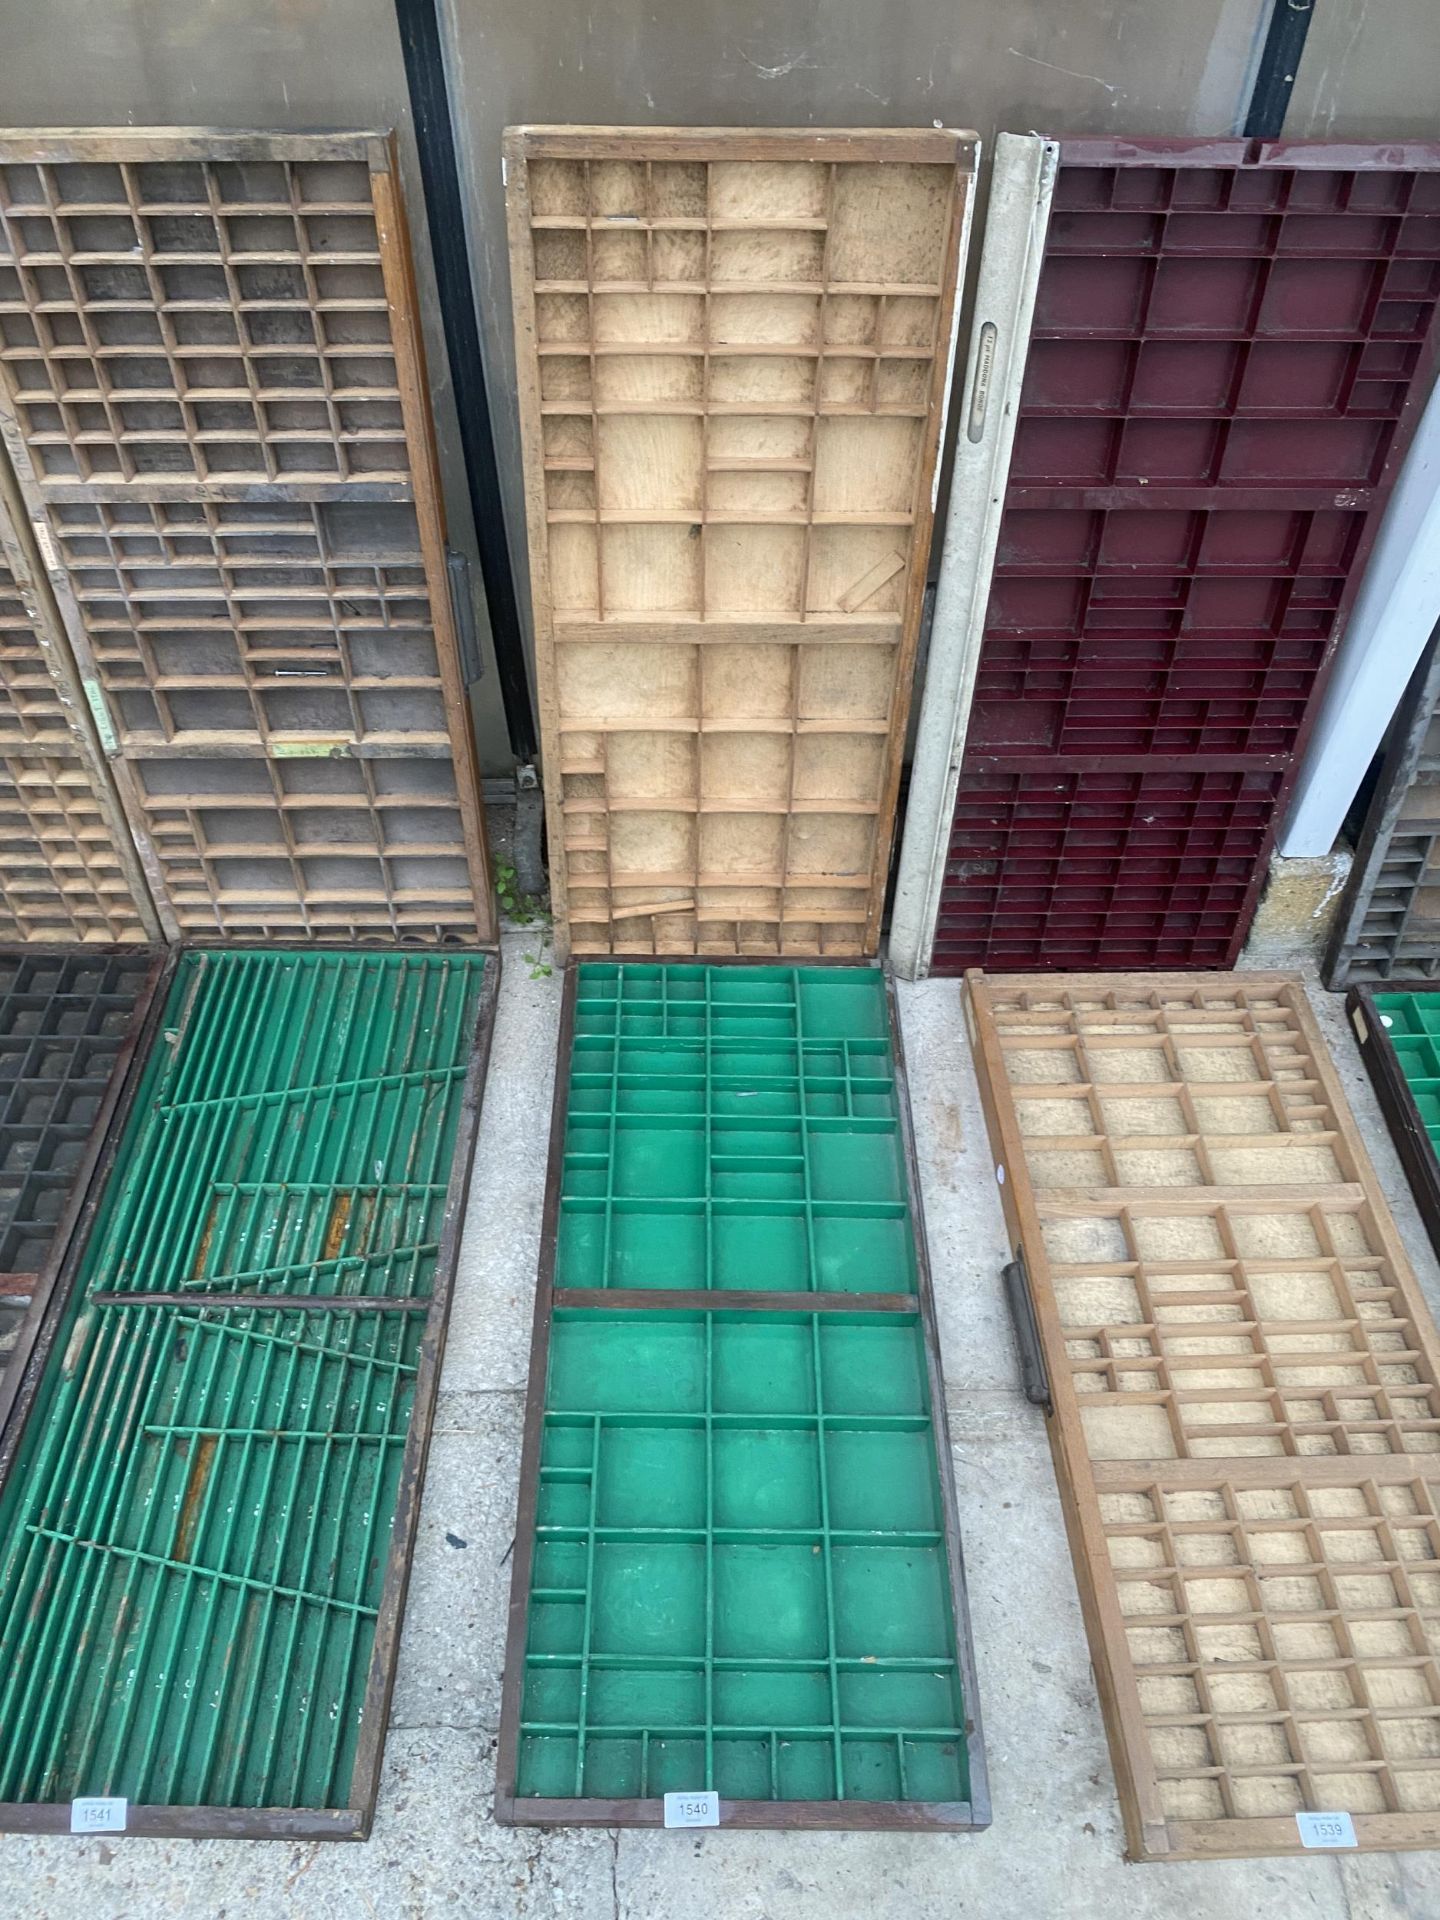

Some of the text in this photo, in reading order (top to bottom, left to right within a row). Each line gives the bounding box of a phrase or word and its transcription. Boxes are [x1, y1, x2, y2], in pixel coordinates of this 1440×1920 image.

[84, 1808, 111, 1822] 1541
[680, 1803, 708, 1815] 1540
[1313, 1824, 1343, 1836] 1539
